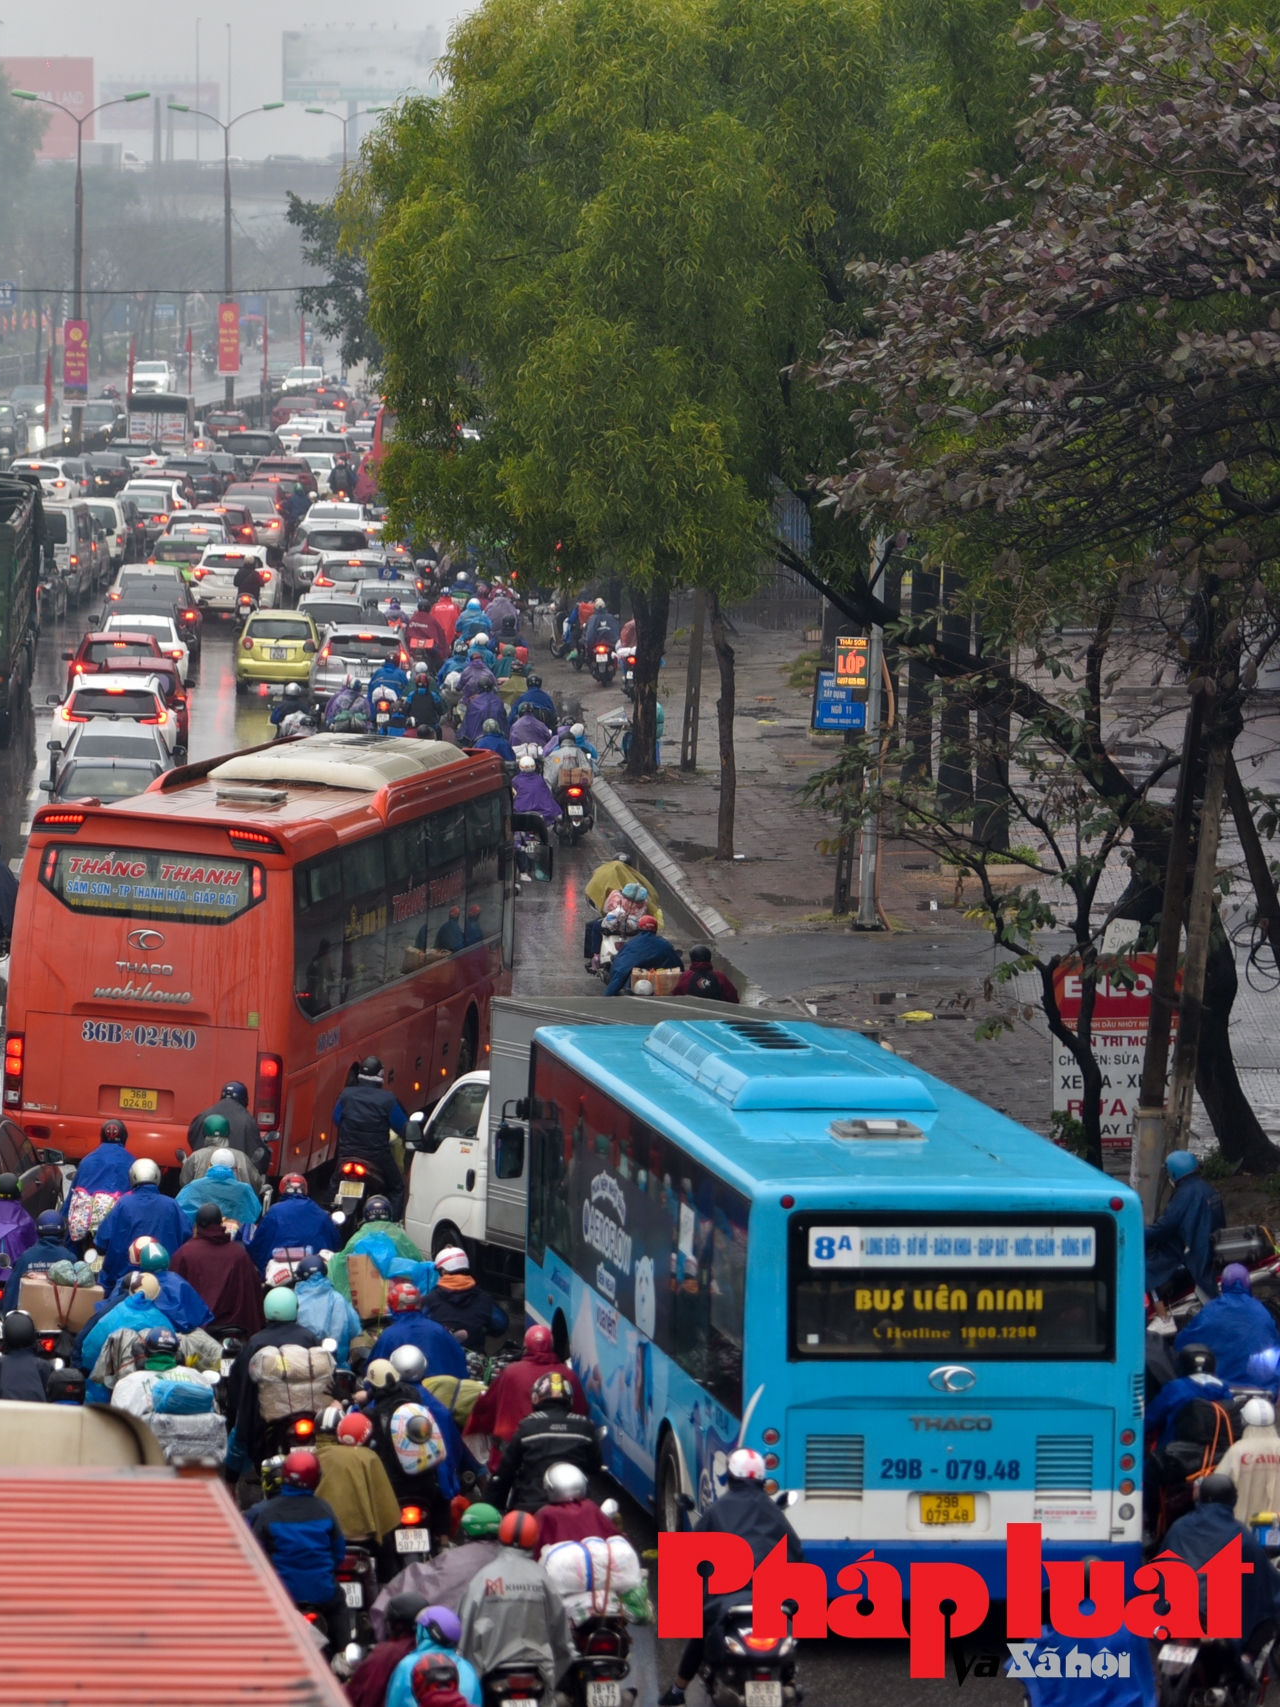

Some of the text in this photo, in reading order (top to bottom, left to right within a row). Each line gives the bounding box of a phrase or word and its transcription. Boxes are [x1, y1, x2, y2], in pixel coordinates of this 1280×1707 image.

[837, 649, 866, 675] LỐP
[69, 852, 242, 887] THẮNG THANH
[91, 883, 111, 898] SƠN
[119, 886, 131, 898] TP
[133, 887, 164, 901] THANH
[167, 886, 186, 904] HÓA
[115, 961, 173, 976] THACO
[93, 980, 194, 1005] mobihome
[1114, 1050, 1140, 1065] SỬA
[130, 1091, 147, 1100] 36B
[123, 1099, 152, 1109] 024.80
[814, 1235, 853, 1260] 8A
[855, 1284, 1043, 1311] BUS LIÊN NINH
[886, 1326, 951, 1338] Hotline
[909, 1416, 992, 1431] THACO
[880, 1459, 922, 1480] 29B
[945, 1461, 1020, 1481] 079.48
[935, 1496, 959, 1508] 29B
[926, 1509, 969, 1521] 079.48
